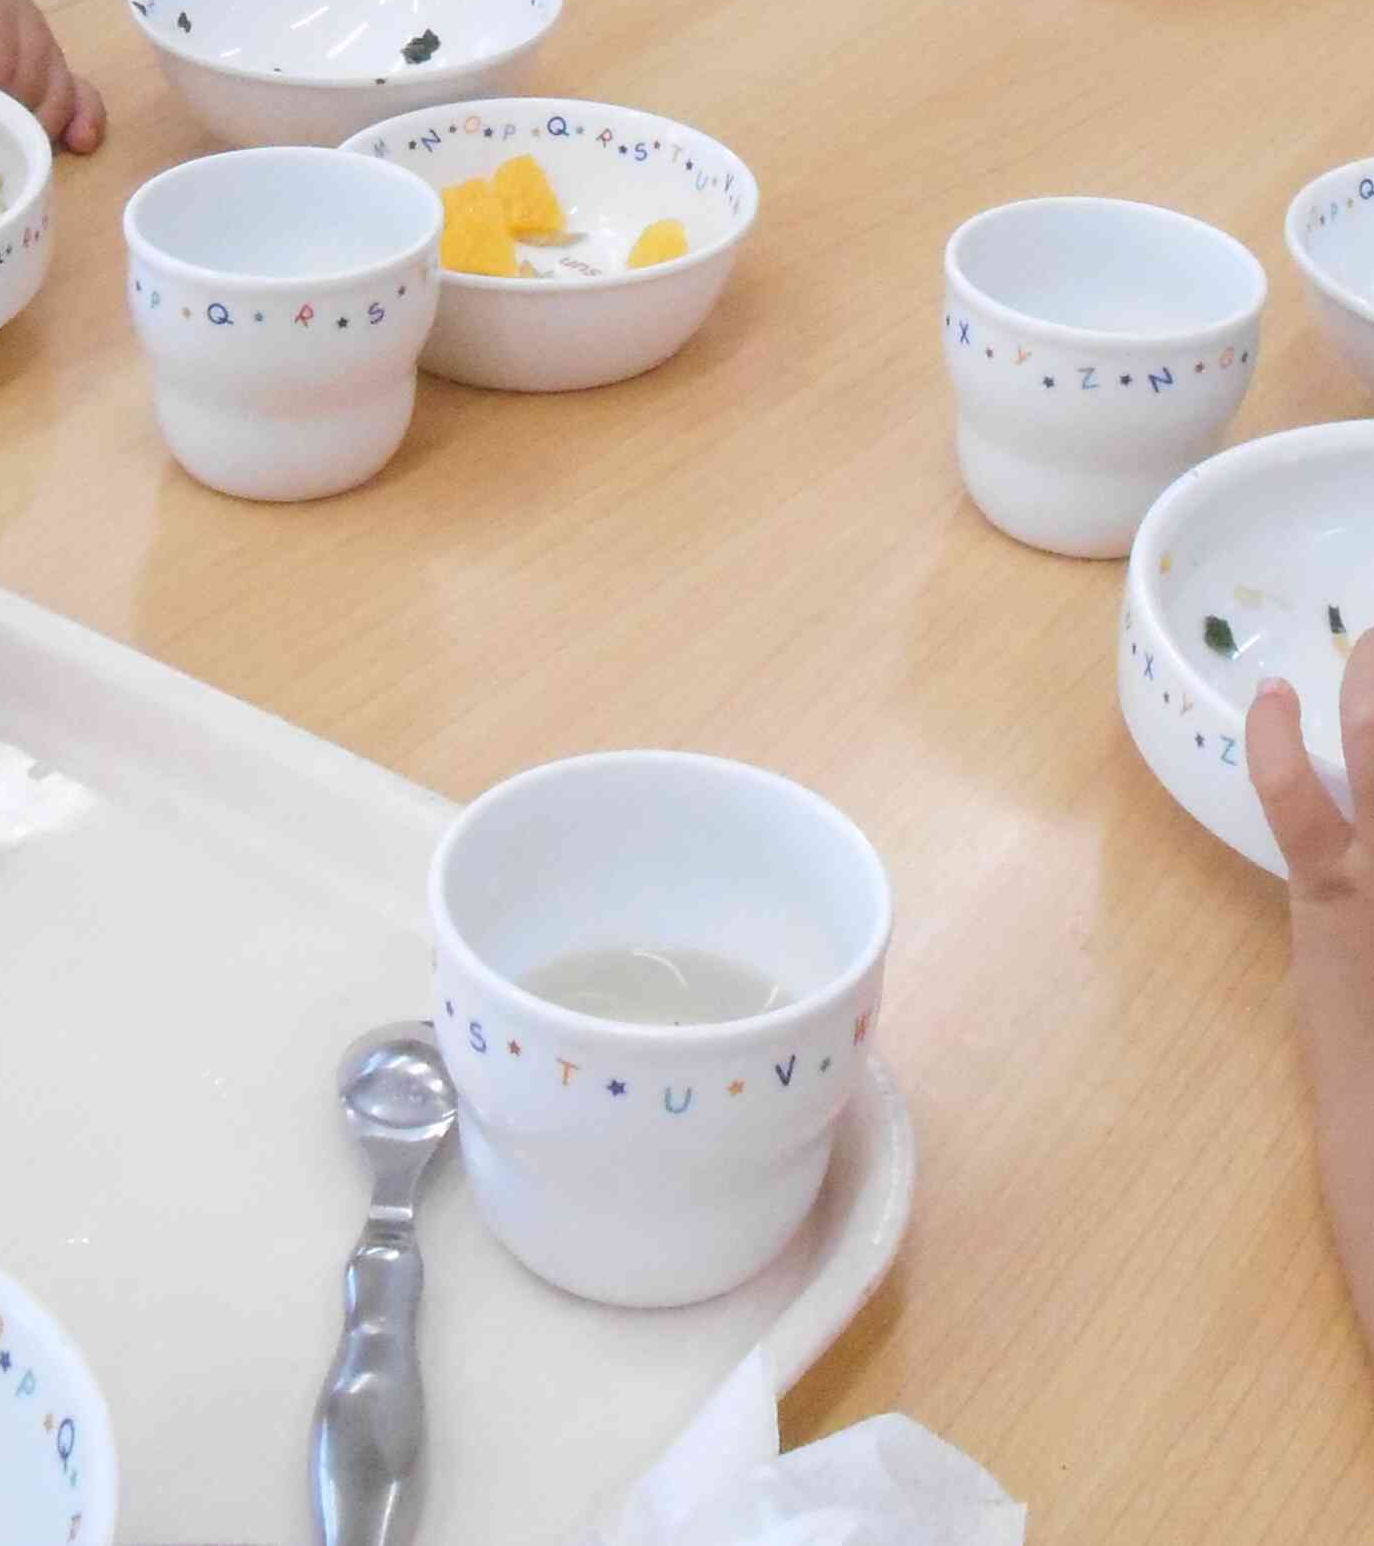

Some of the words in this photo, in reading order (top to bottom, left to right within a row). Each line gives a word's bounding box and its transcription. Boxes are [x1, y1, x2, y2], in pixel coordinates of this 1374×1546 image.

[421, 129, 441, 152] N
[465, 115, 481, 134] O
[502, 123, 516, 141] P
[547, 116, 569, 136] Q
[596, 128, 613, 147] R
[634, 142, 648, 161] S
[672, 144, 684, 163] T
[207, 303, 233, 325] Q
[294, 304, 314, 327] R
[368, 302, 385, 325] S
[959, 321, 970, 344] X
[1078, 366, 1099, 390] Z
[1148, 367, 1173, 393] N
[1144, 654, 1153, 680] X
[1220, 735, 1237, 766] Z
[469, 1021, 487, 1054] S
[556, 1058, 580, 1086] T
[664, 1087, 692, 1114] U
[775, 1055, 796, 1086] V
[15, 1369, 36, 1397] P
